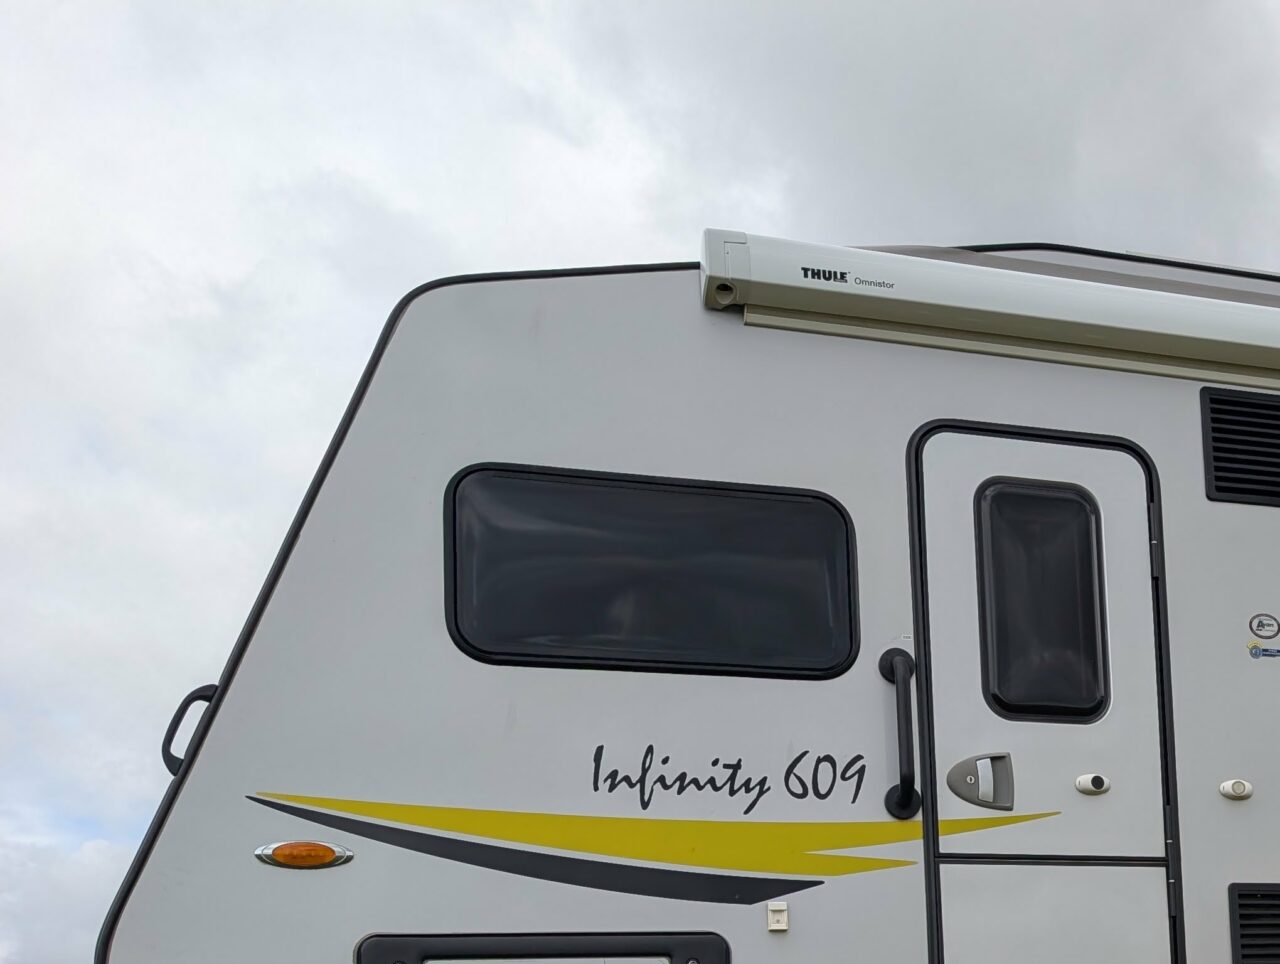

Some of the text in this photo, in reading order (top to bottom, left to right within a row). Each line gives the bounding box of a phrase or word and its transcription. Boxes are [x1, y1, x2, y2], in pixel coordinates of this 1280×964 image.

[801, 267, 895, 289] THULE Omnistor
[593, 744, 867, 815] Infinity 609
